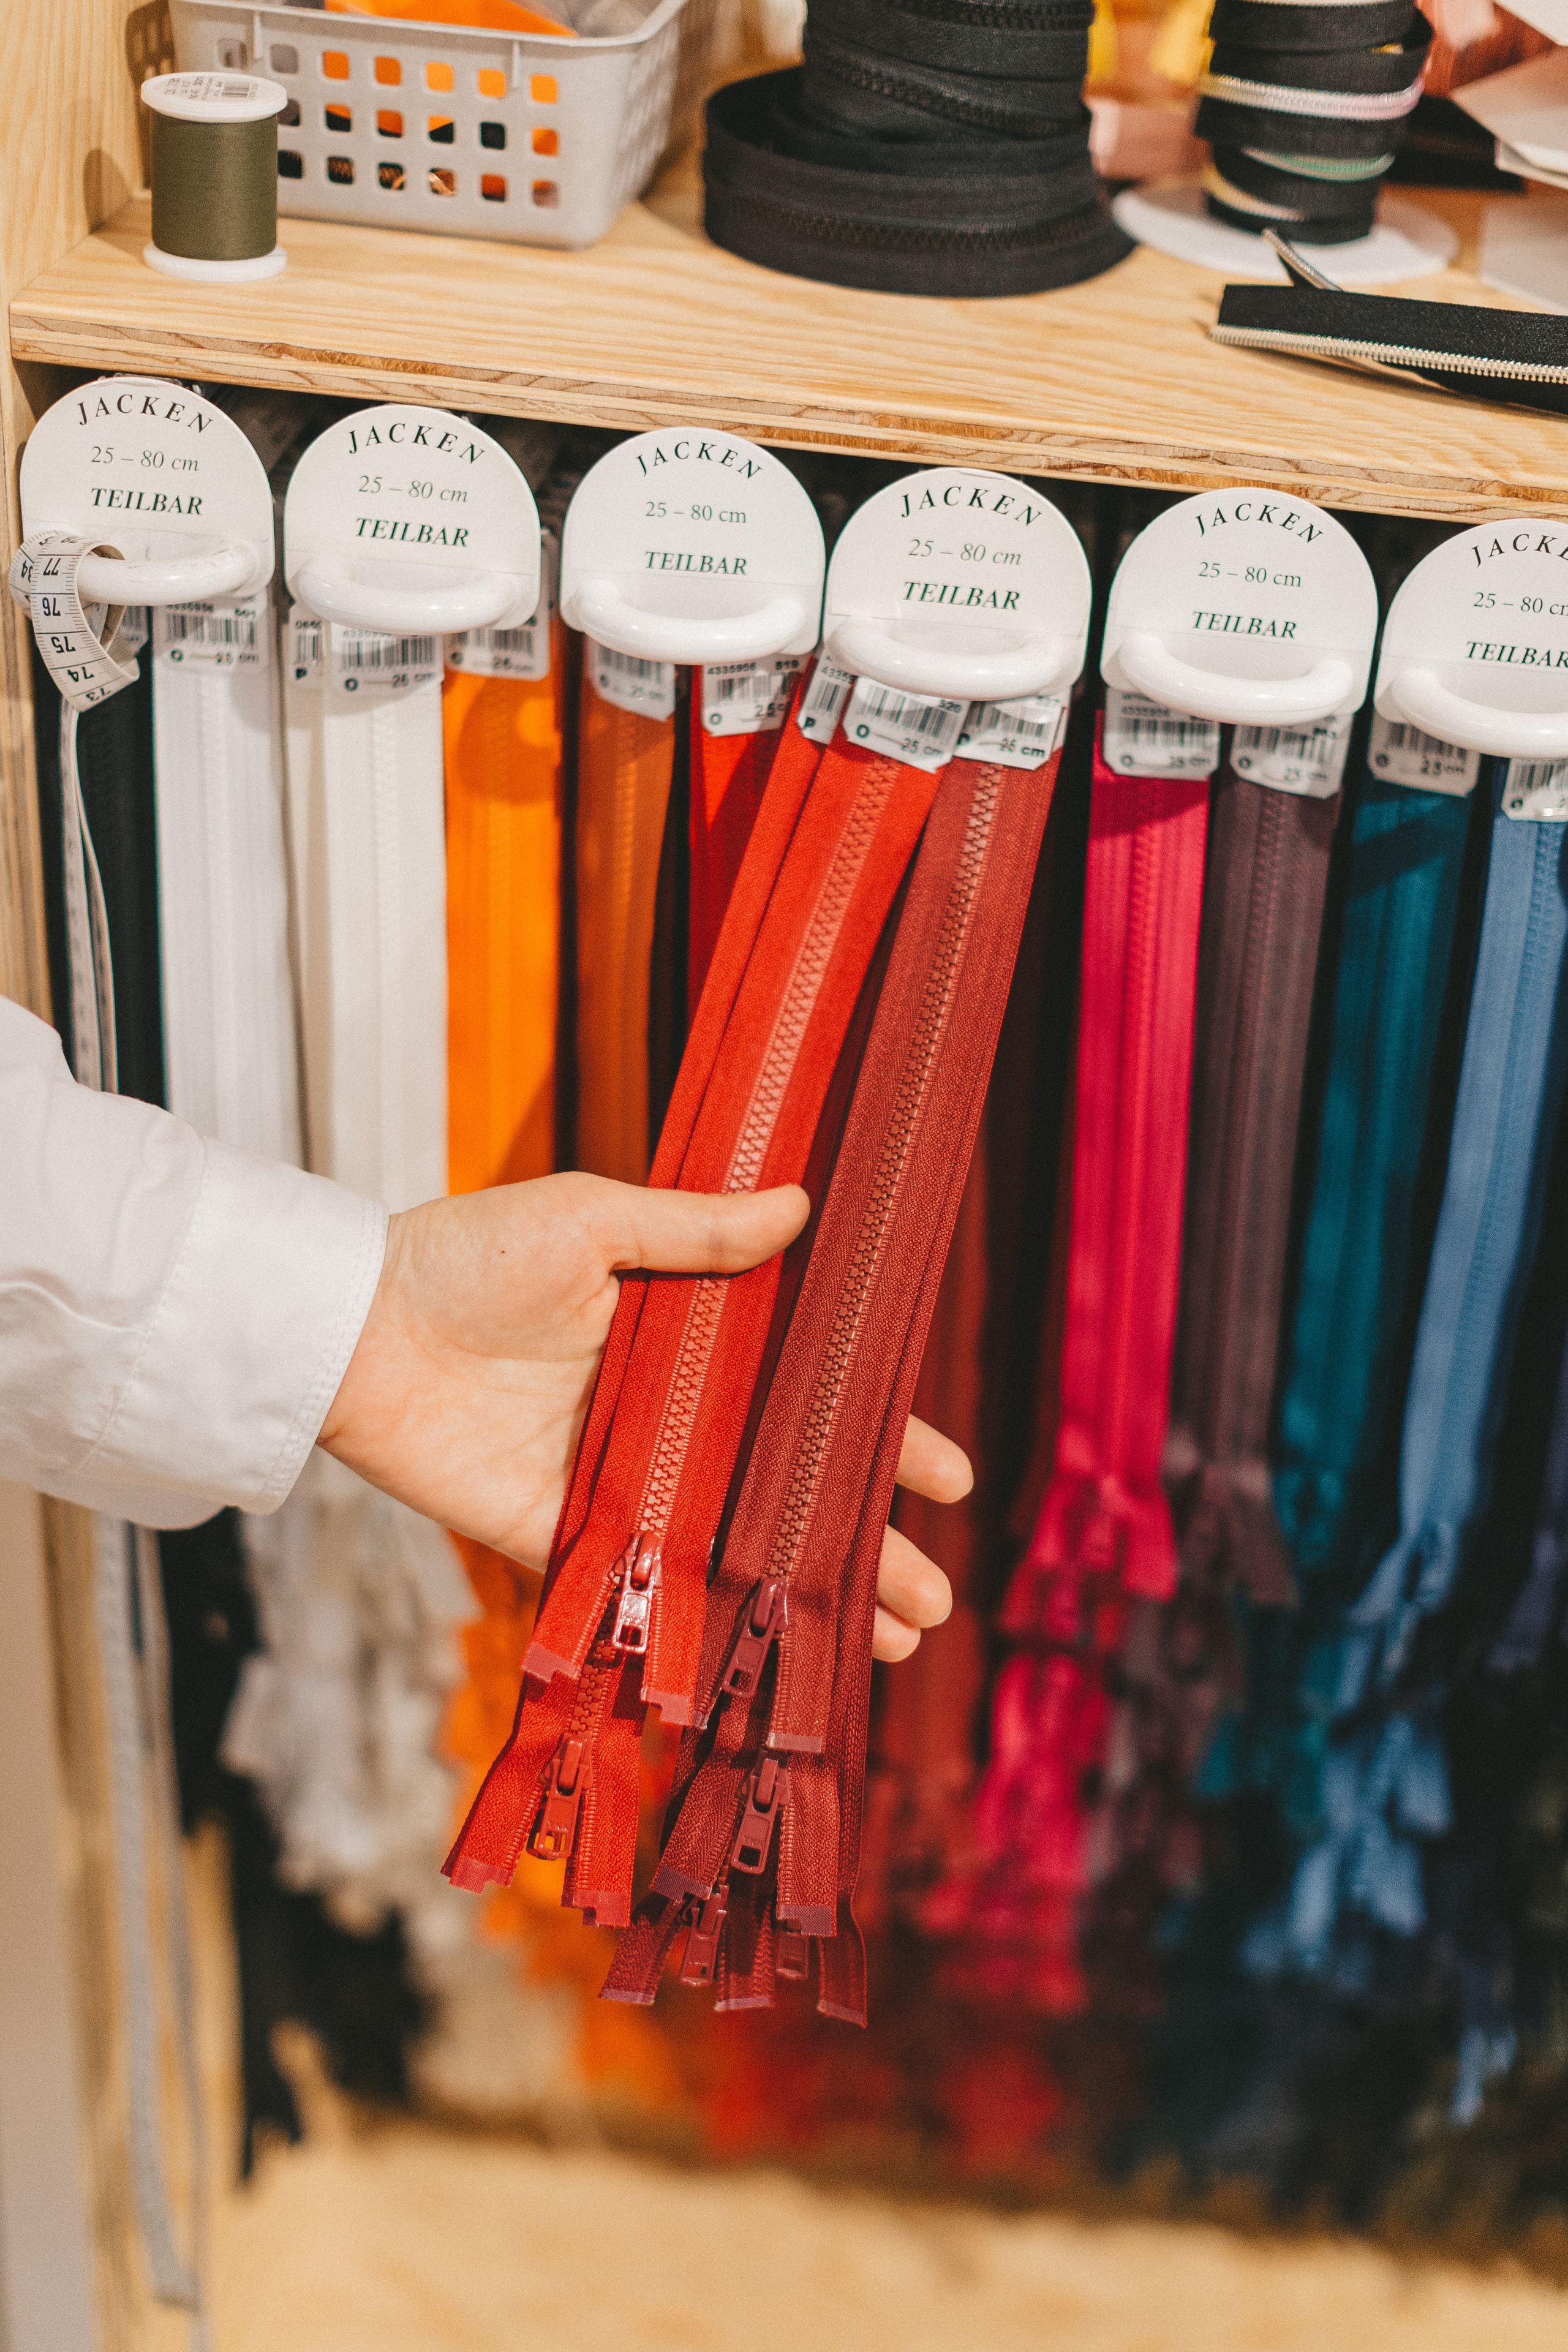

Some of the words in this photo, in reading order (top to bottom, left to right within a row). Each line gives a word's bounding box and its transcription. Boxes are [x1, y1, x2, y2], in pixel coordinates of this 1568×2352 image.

[78, 394, 213, 433] JACKEN
[349, 423, 485, 464] JACKEN
[91, 445, 114, 464] 25
[140, 450, 165, 468] 80
[171, 459, 198, 472] cm
[637, 442, 763, 478] JACKEN
[91, 488, 203, 515] TEILBAR
[358, 475, 382, 494] 25
[409, 480, 434, 499] 80
[439, 489, 467, 503] cm
[646, 501, 667, 518] 25
[690, 504, 713, 521] 80
[718, 511, 747, 524] cm
[901, 486, 1042, 526] JACKEN
[356, 518, 469, 547] TEILBAR
[1196, 503, 1324, 543] JACKEN
[646, 551, 747, 575] TEILBAR
[908, 538, 934, 557] 25
[960, 543, 986, 562] 80
[992, 552, 1021, 565] cm
[43, 558, 61, 576] 77
[1198, 561, 1220, 578] 25
[1244, 567, 1267, 583] 80
[1273, 574, 1302, 587] cm
[42, 597, 61, 616] 76
[903, 582, 1020, 610] TEILBAR
[1473, 592, 1496, 609] 25
[1520, 597, 1544, 613] 80
[1193, 611, 1297, 638] TEILBAR
[51, 636, 77, 653] 75
[1466, 641, 1568, 668] TEILBAR
[67, 666, 95, 682] 74
[86, 688, 111, 701] 73
[901, 737, 919, 755] 25
[1021, 746, 1046, 758] cm
